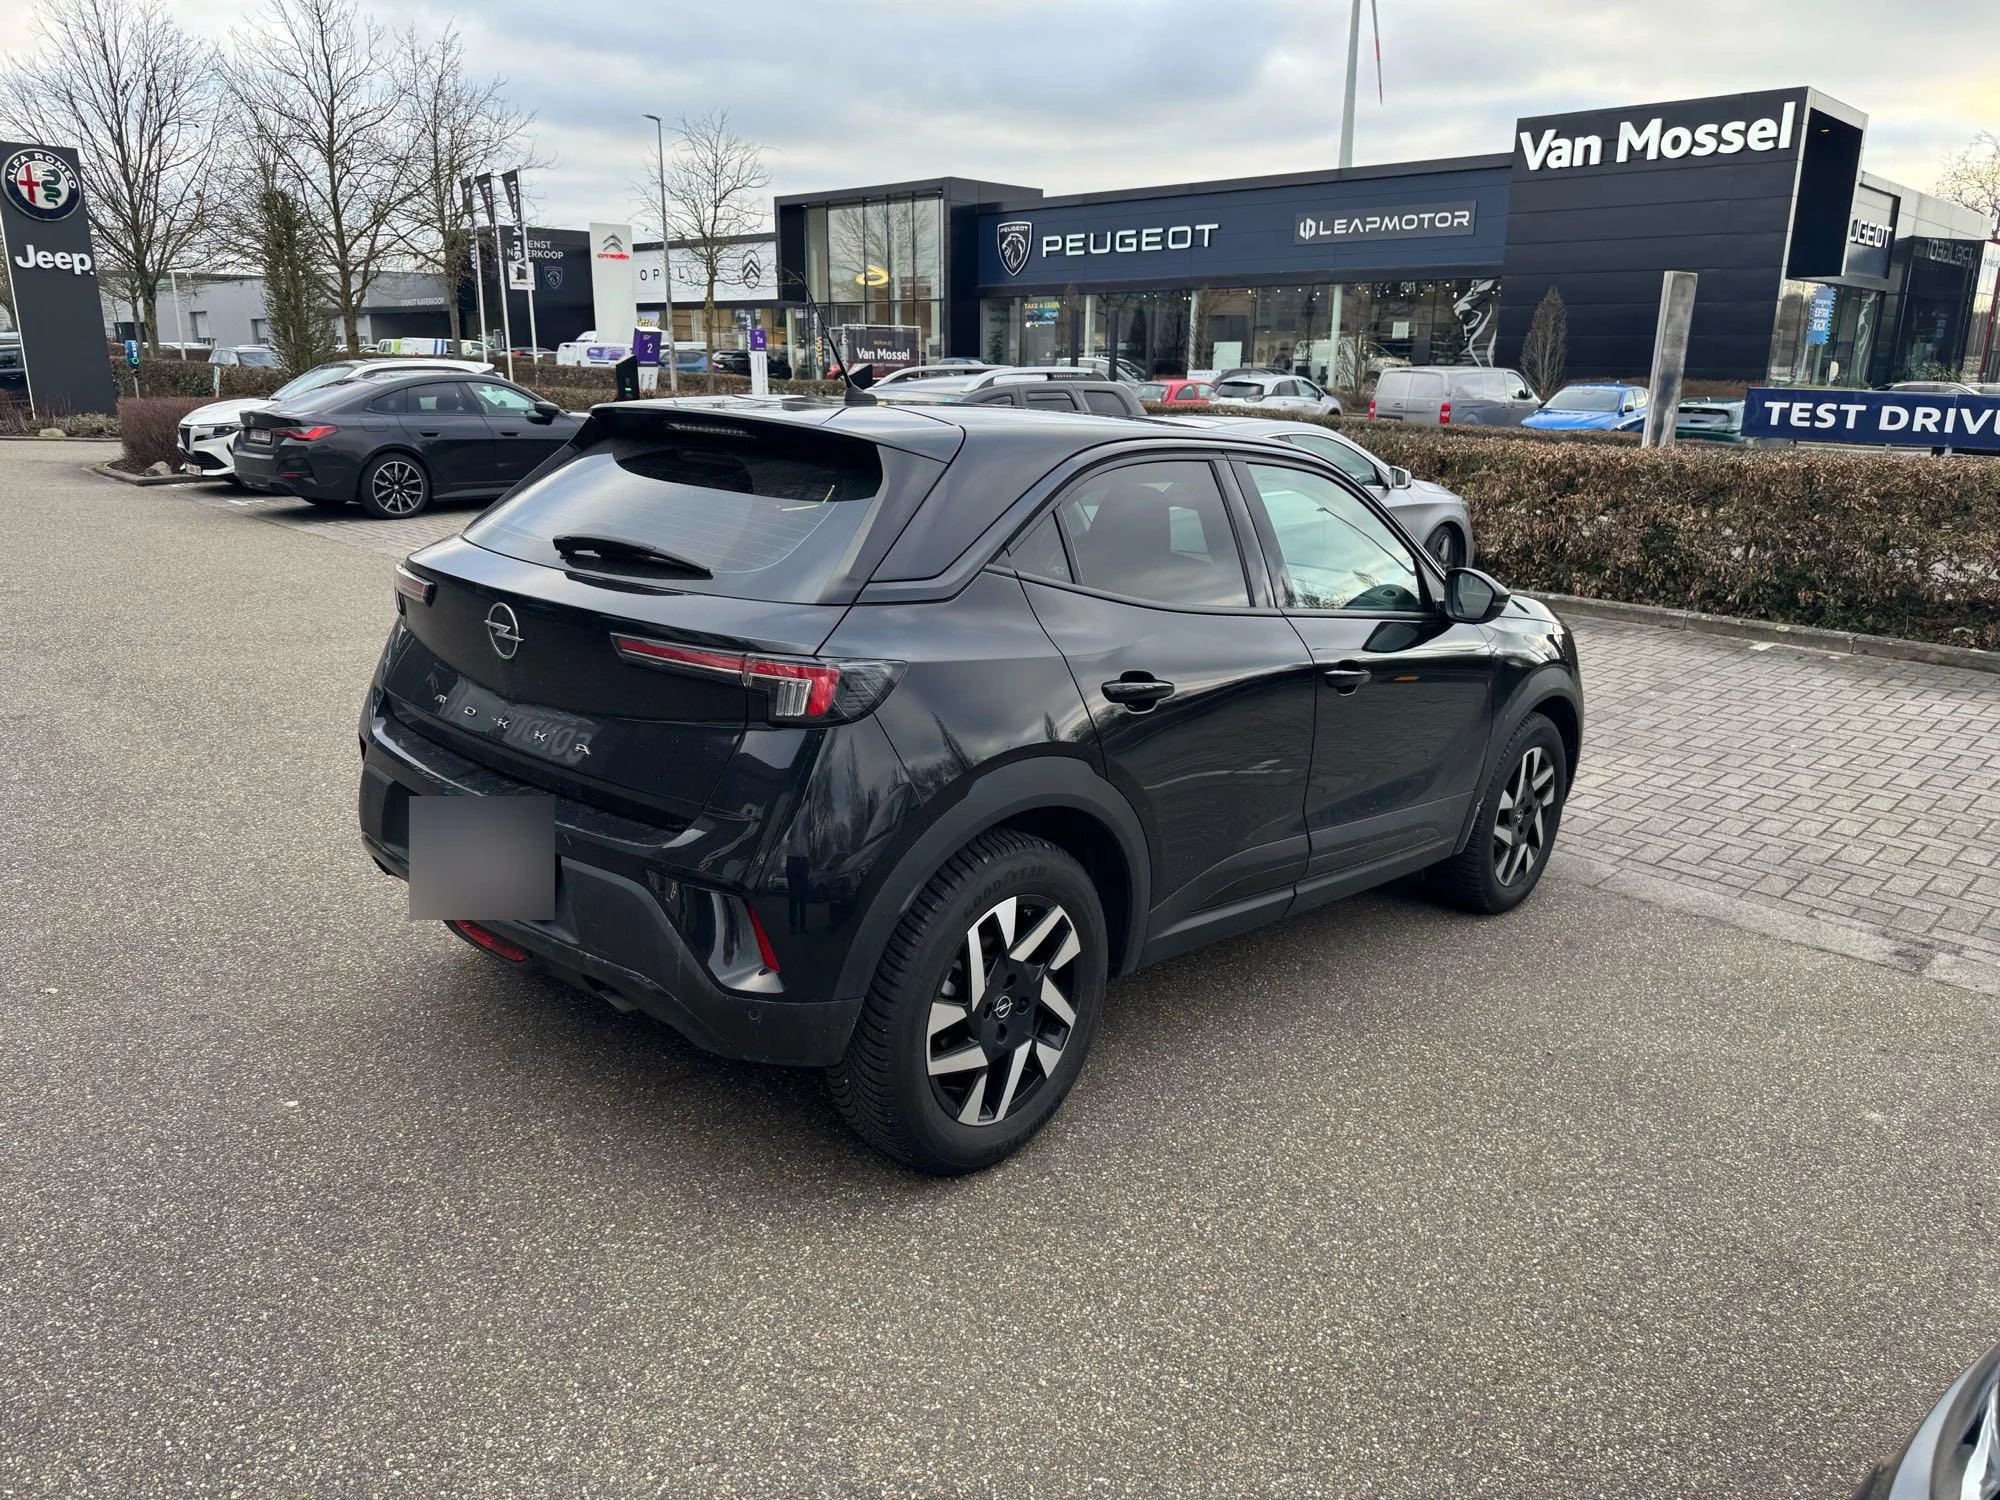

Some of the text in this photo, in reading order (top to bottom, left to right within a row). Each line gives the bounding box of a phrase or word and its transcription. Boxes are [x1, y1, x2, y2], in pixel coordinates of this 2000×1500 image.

[1519, 101, 1796, 171] Van Mossel
[7, 152, 77, 189] ALFA ROMEO
[1319, 210, 1470, 236] LEAPMOTOR
[1850, 218, 1893, 249] UGEOT
[527, 239, 552, 249] ENST
[1043, 223, 1219, 257] PEUGEOT
[647, 343, 653, 353] 2
[857, 347, 875, 359] Van
[877, 348, 910, 360] Mossel
[1764, 401, 1867, 430] TEST
[434, 694, 592, 756] MOKKA
